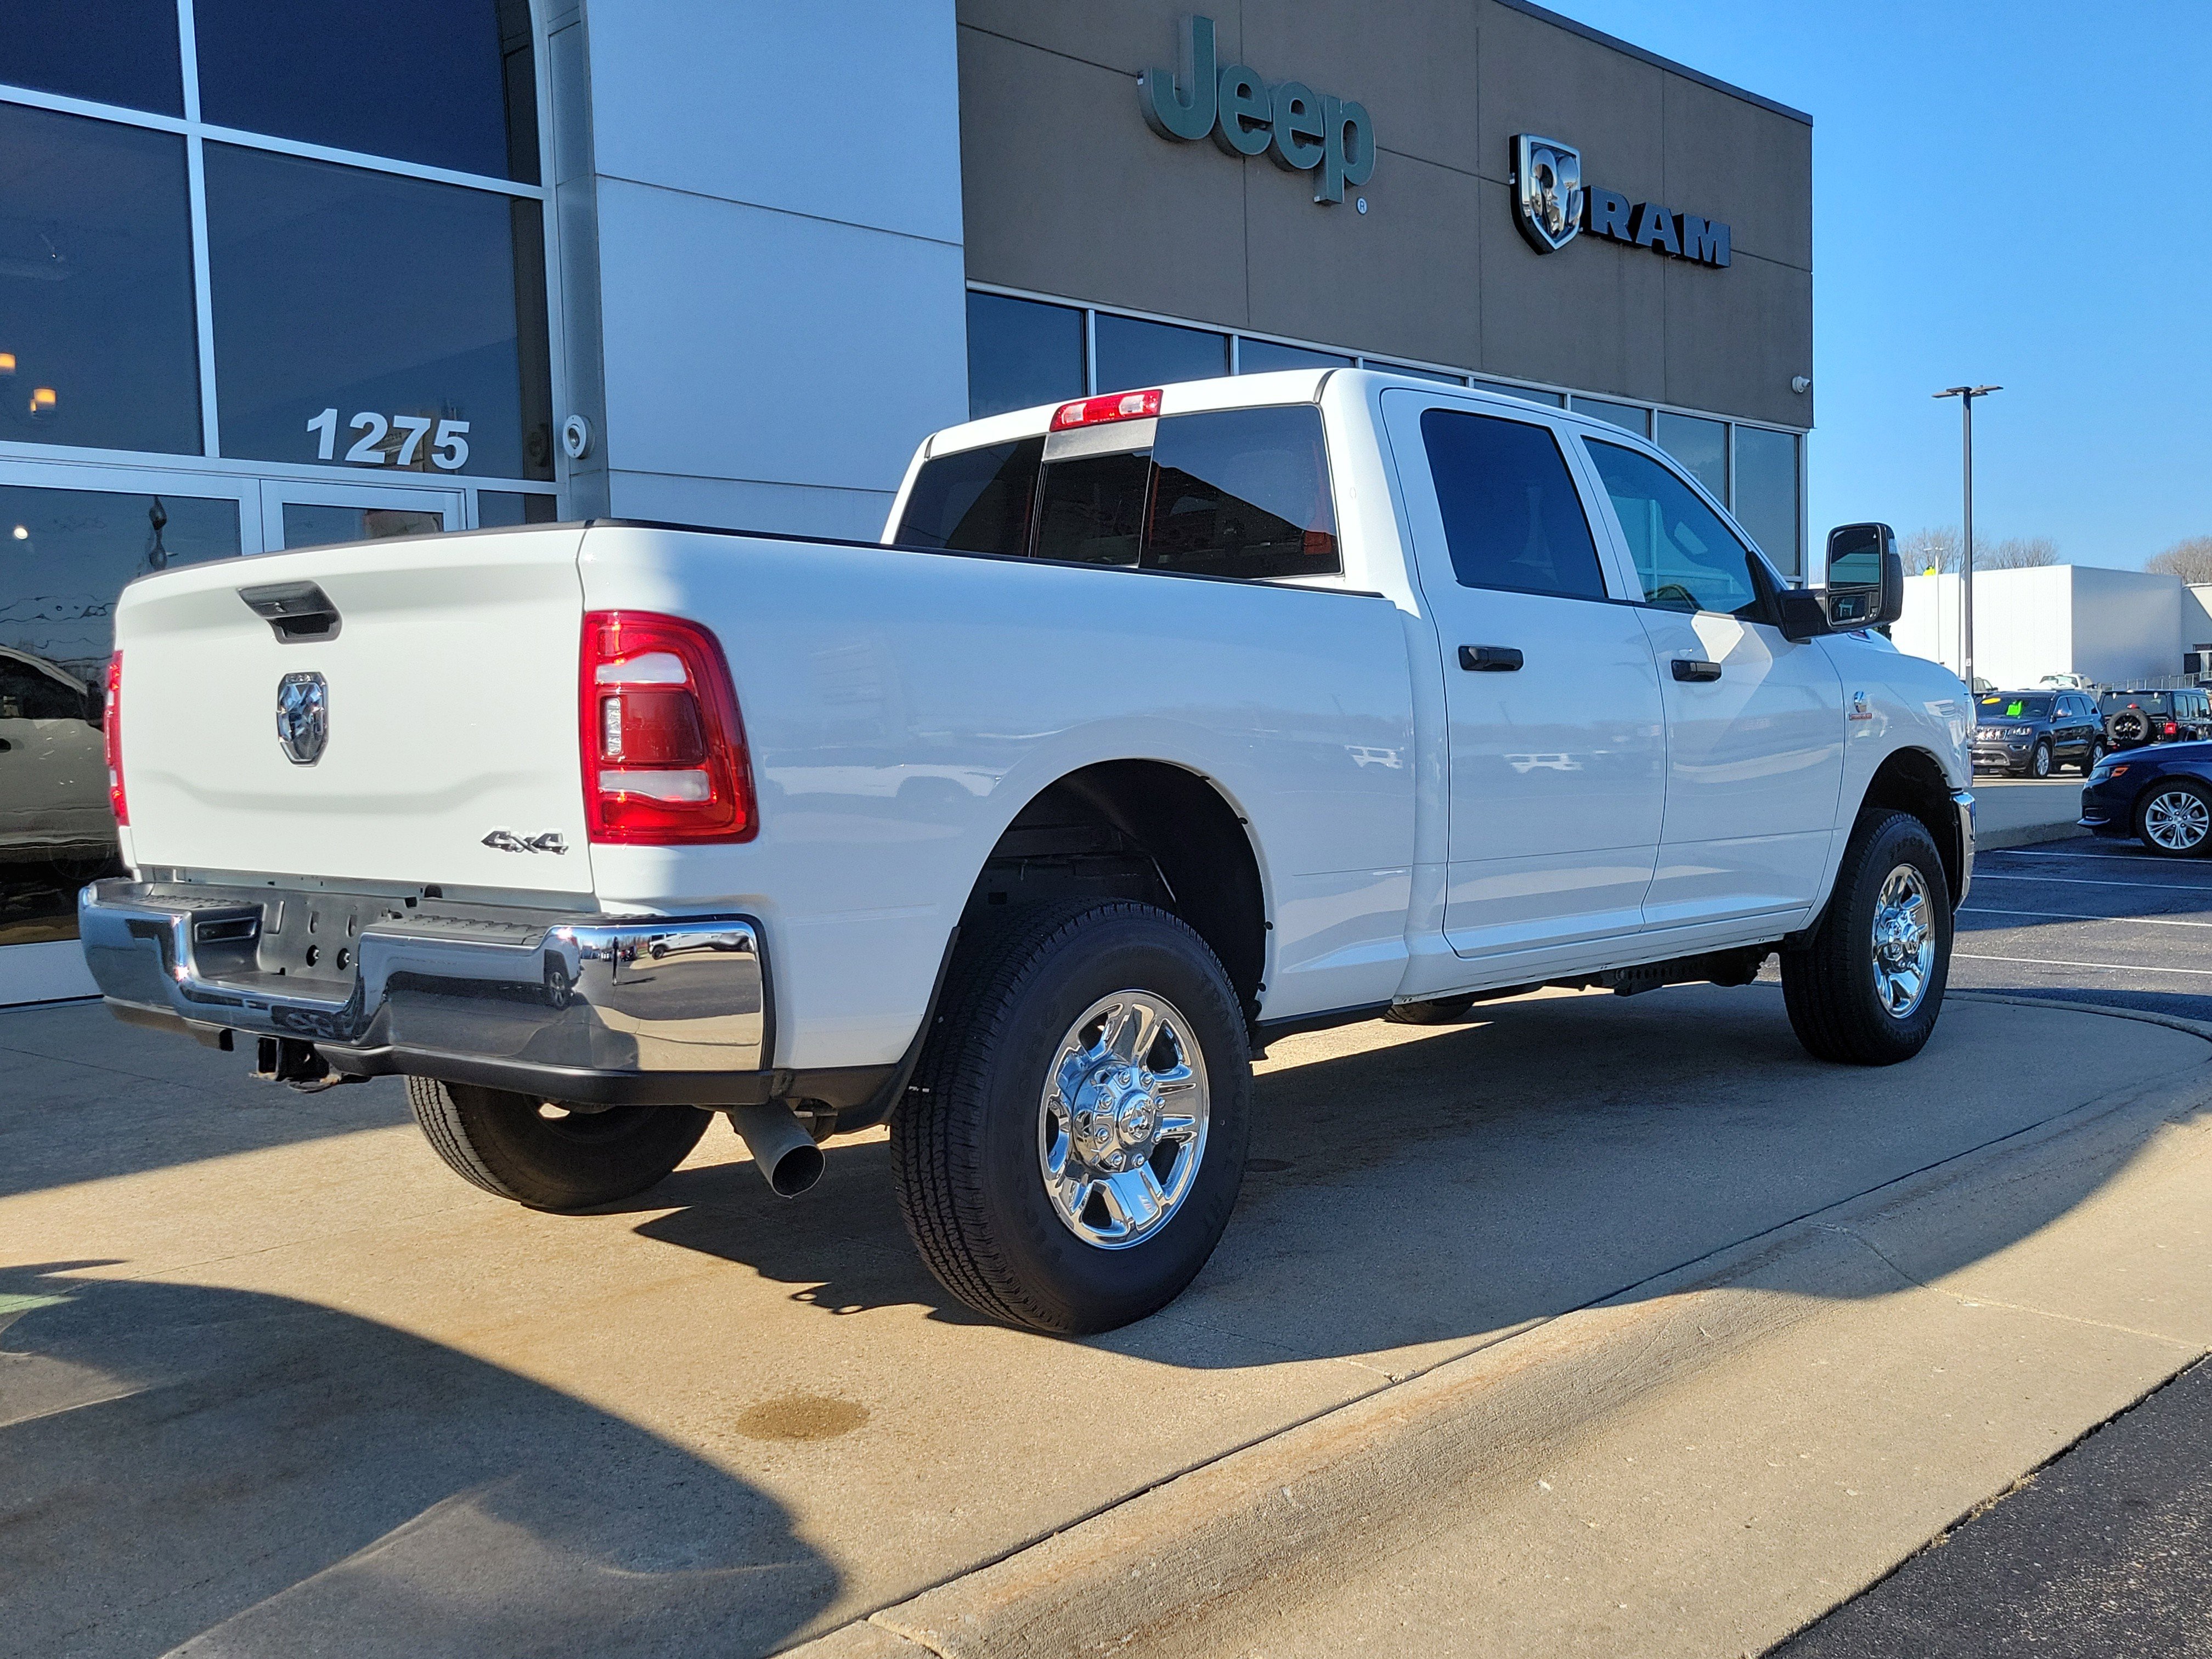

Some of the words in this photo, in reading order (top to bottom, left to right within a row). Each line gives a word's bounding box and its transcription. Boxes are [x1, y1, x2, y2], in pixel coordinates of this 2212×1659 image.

[1141, 14, 1376, 204] Jeep
[1588, 185, 1731, 268] RAM
[307, 408, 470, 469] 1275
